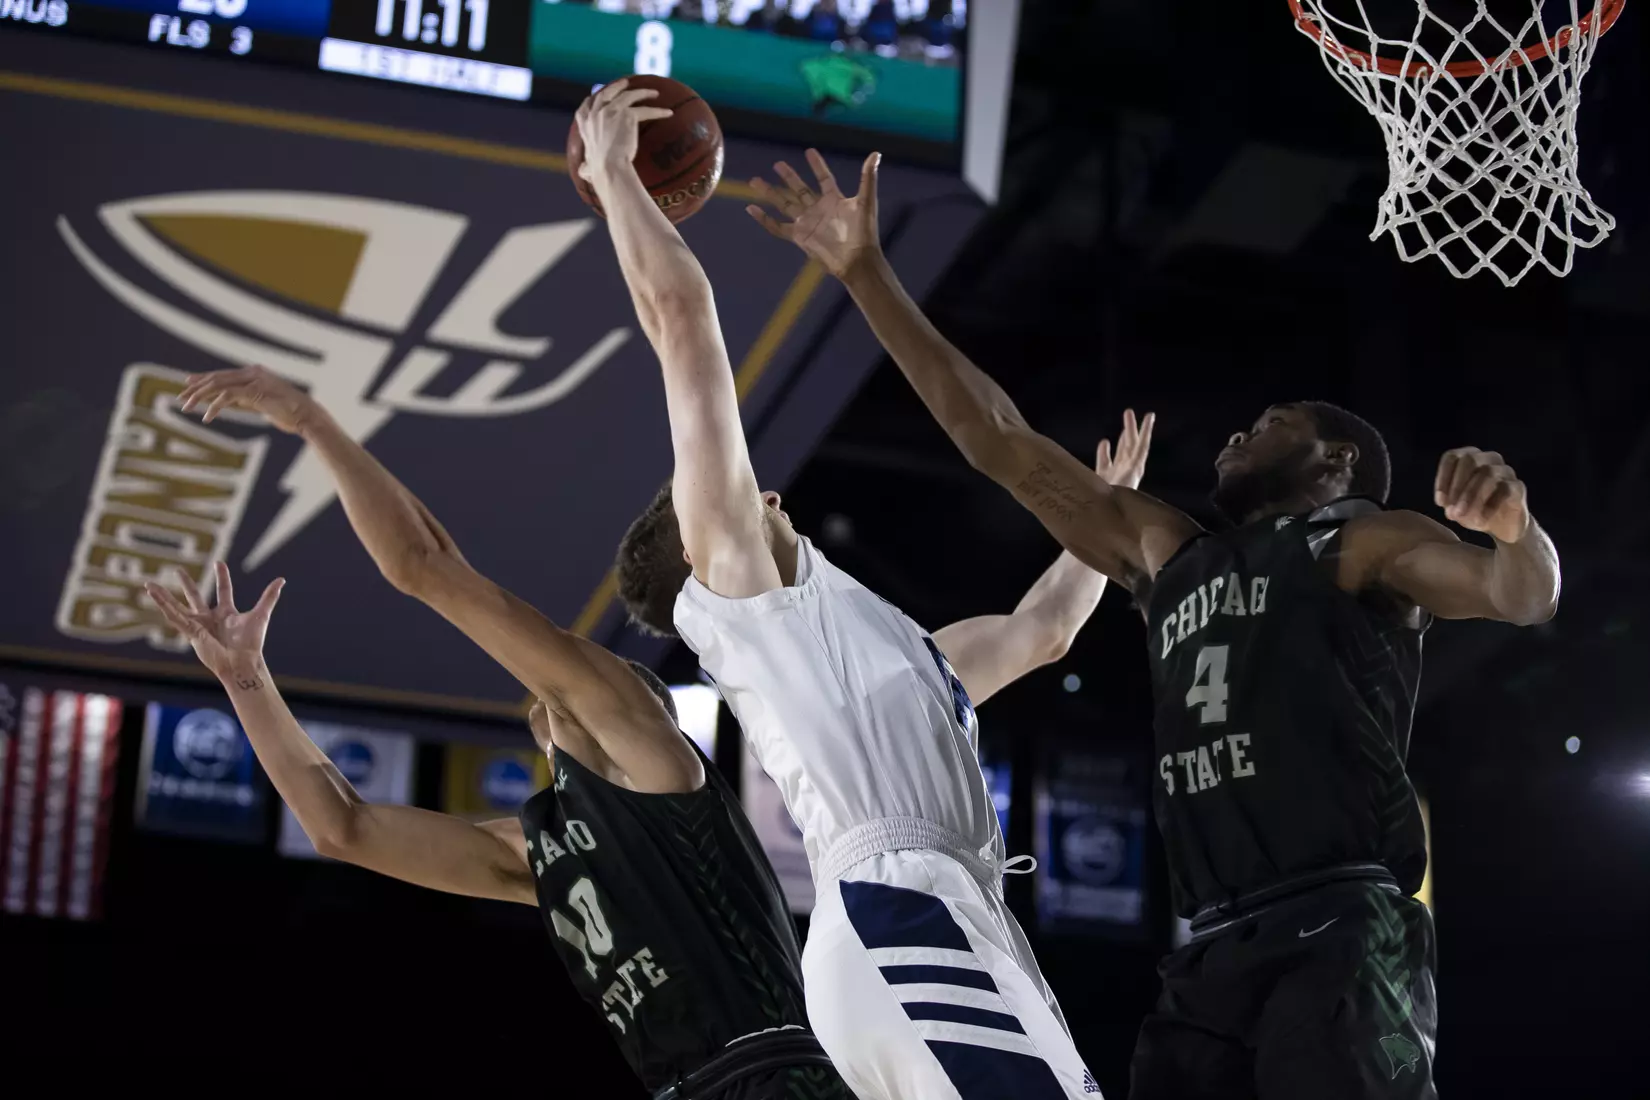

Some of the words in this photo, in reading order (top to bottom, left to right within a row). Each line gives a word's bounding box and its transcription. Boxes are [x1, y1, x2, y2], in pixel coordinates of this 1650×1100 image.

[148, 13, 211, 48] FLS
[229, 26, 253, 55] 3
[634, 20, 673, 77] 8
[1161, 572, 1270, 659] CHICAG
[1185, 645, 1230, 724] 4
[1160, 732, 1256, 796] STATE
